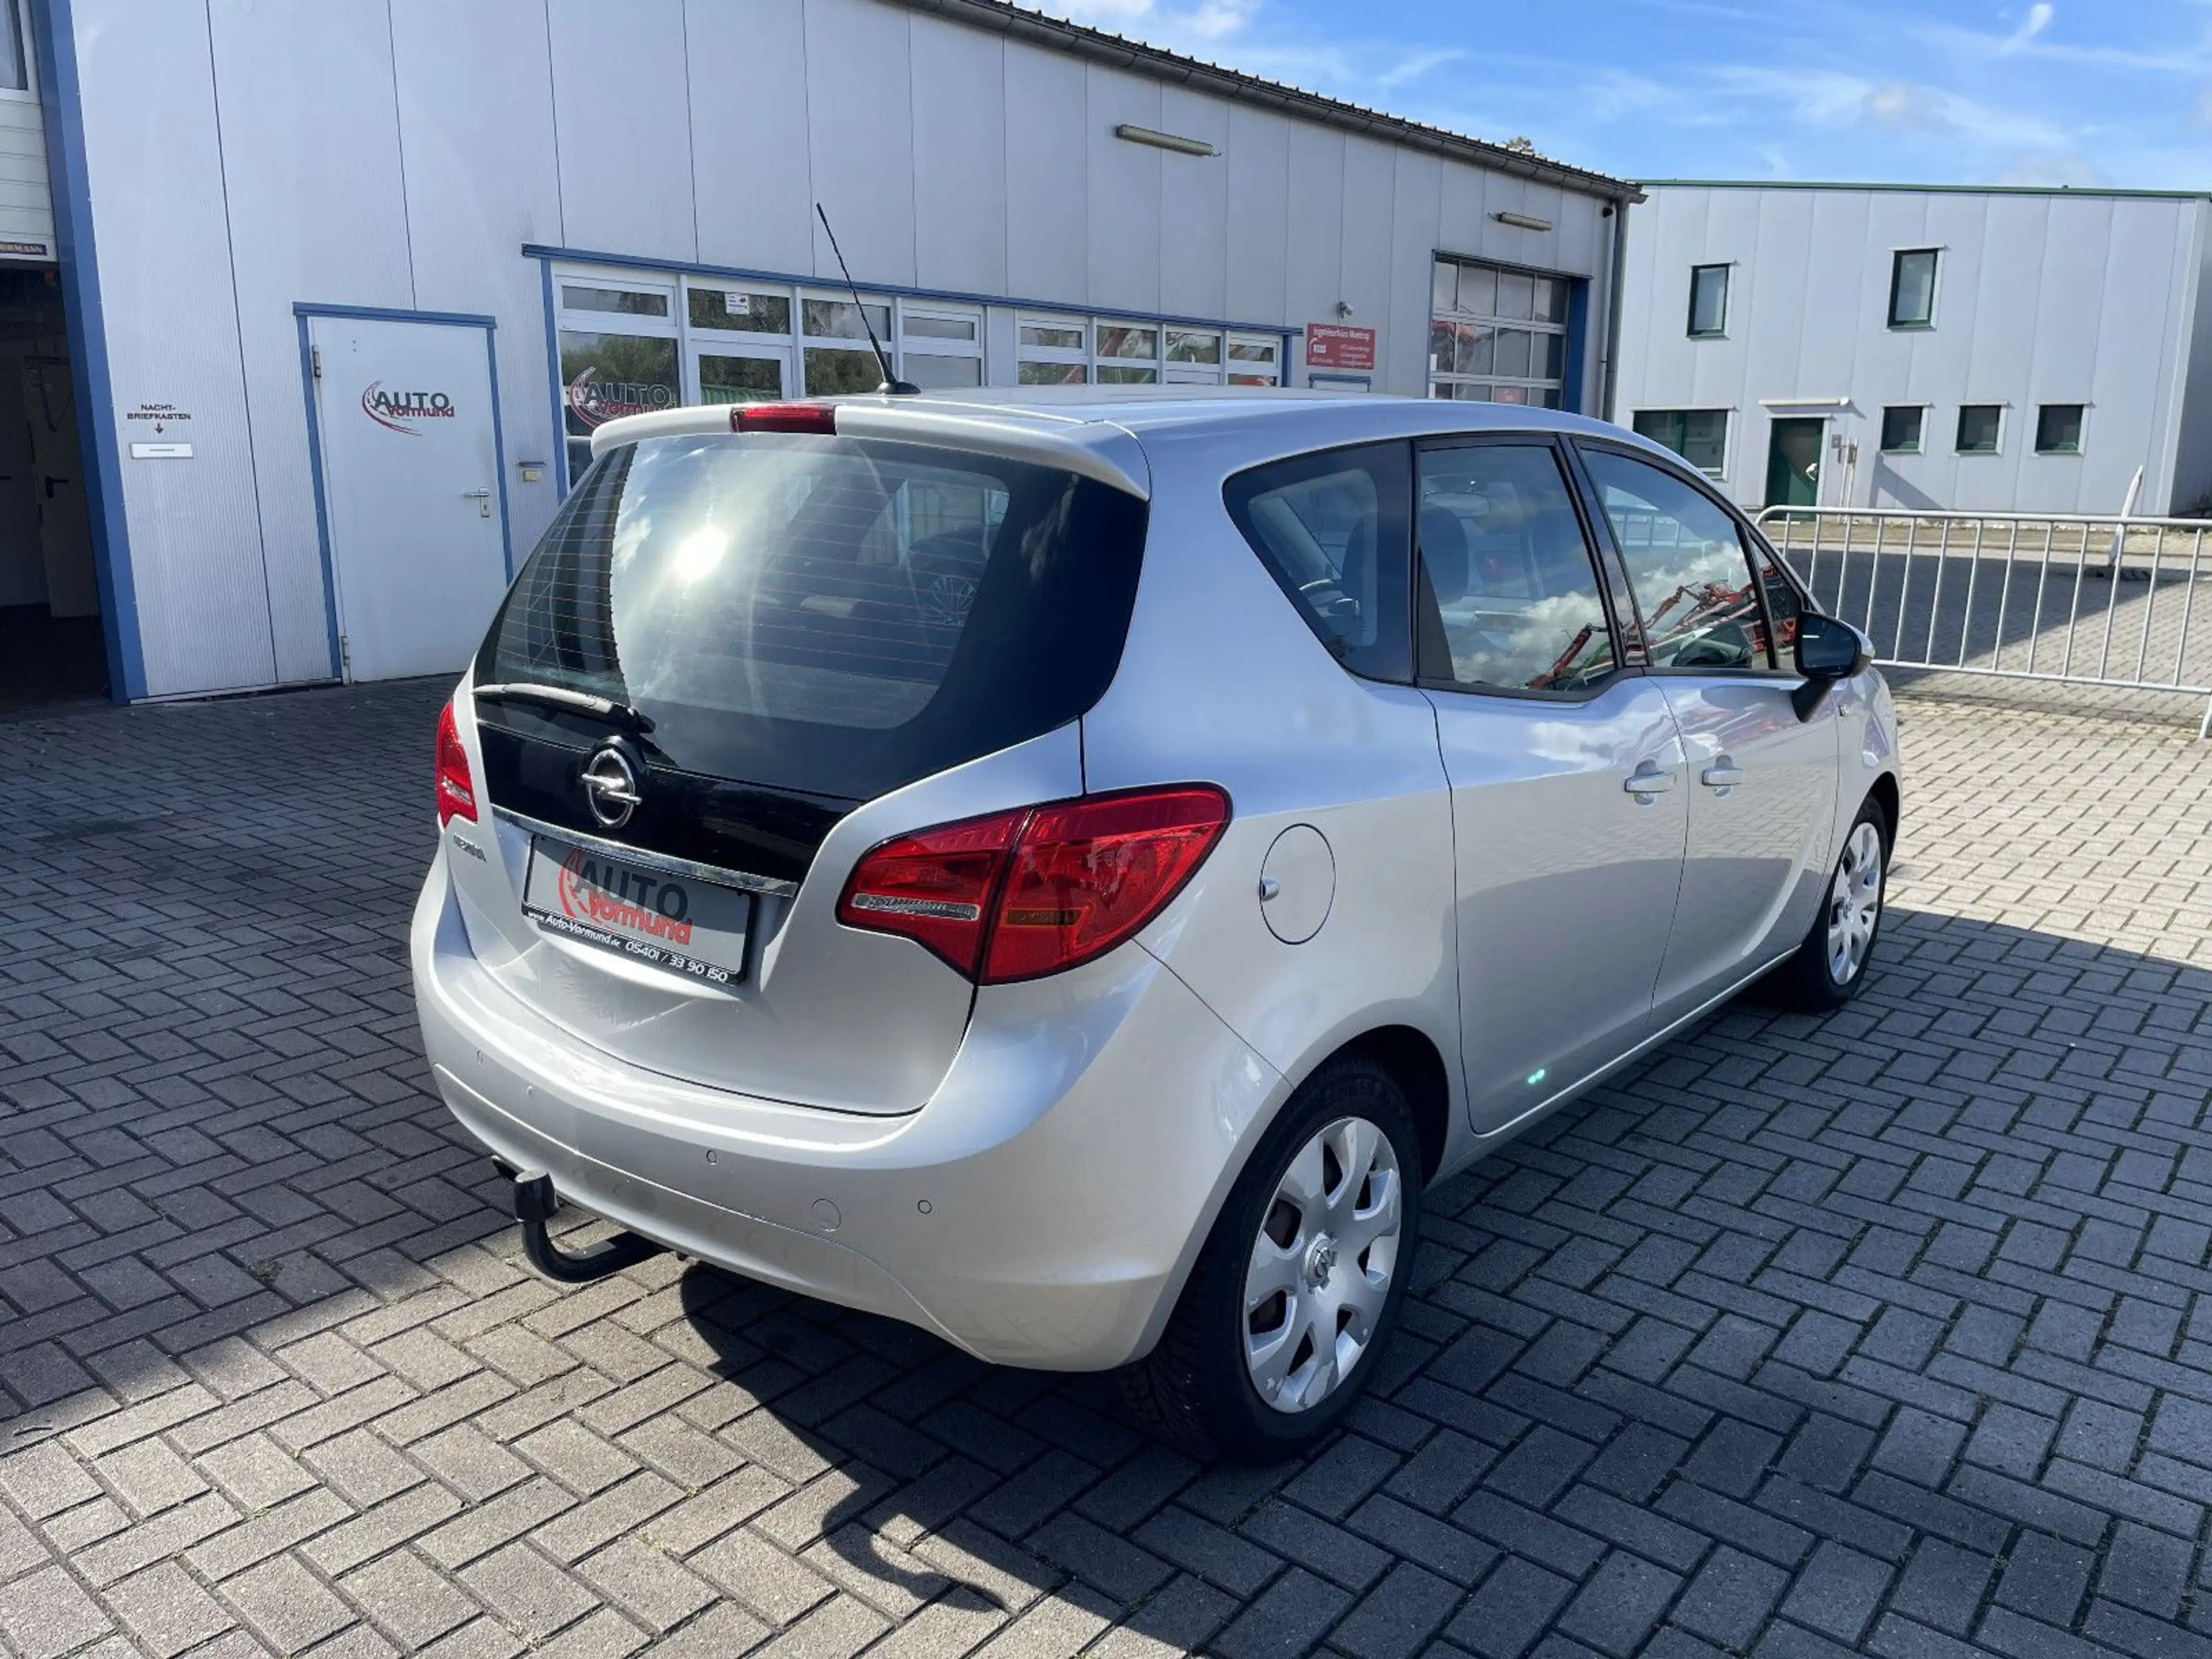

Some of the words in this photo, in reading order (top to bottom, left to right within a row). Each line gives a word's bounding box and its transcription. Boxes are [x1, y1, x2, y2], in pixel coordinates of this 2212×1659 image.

[375, 391, 450, 410] AUTO
[585, 382, 672, 406] AUTO
[389, 406, 454, 417] Vormund
[579, 860, 688, 921] AUTO
[588, 889, 694, 946] Vormund
[625, 941, 660, 960] 05401
[669, 955, 685, 968] 33
[687, 962, 705, 975] 90
[707, 967, 728, 982] 150
